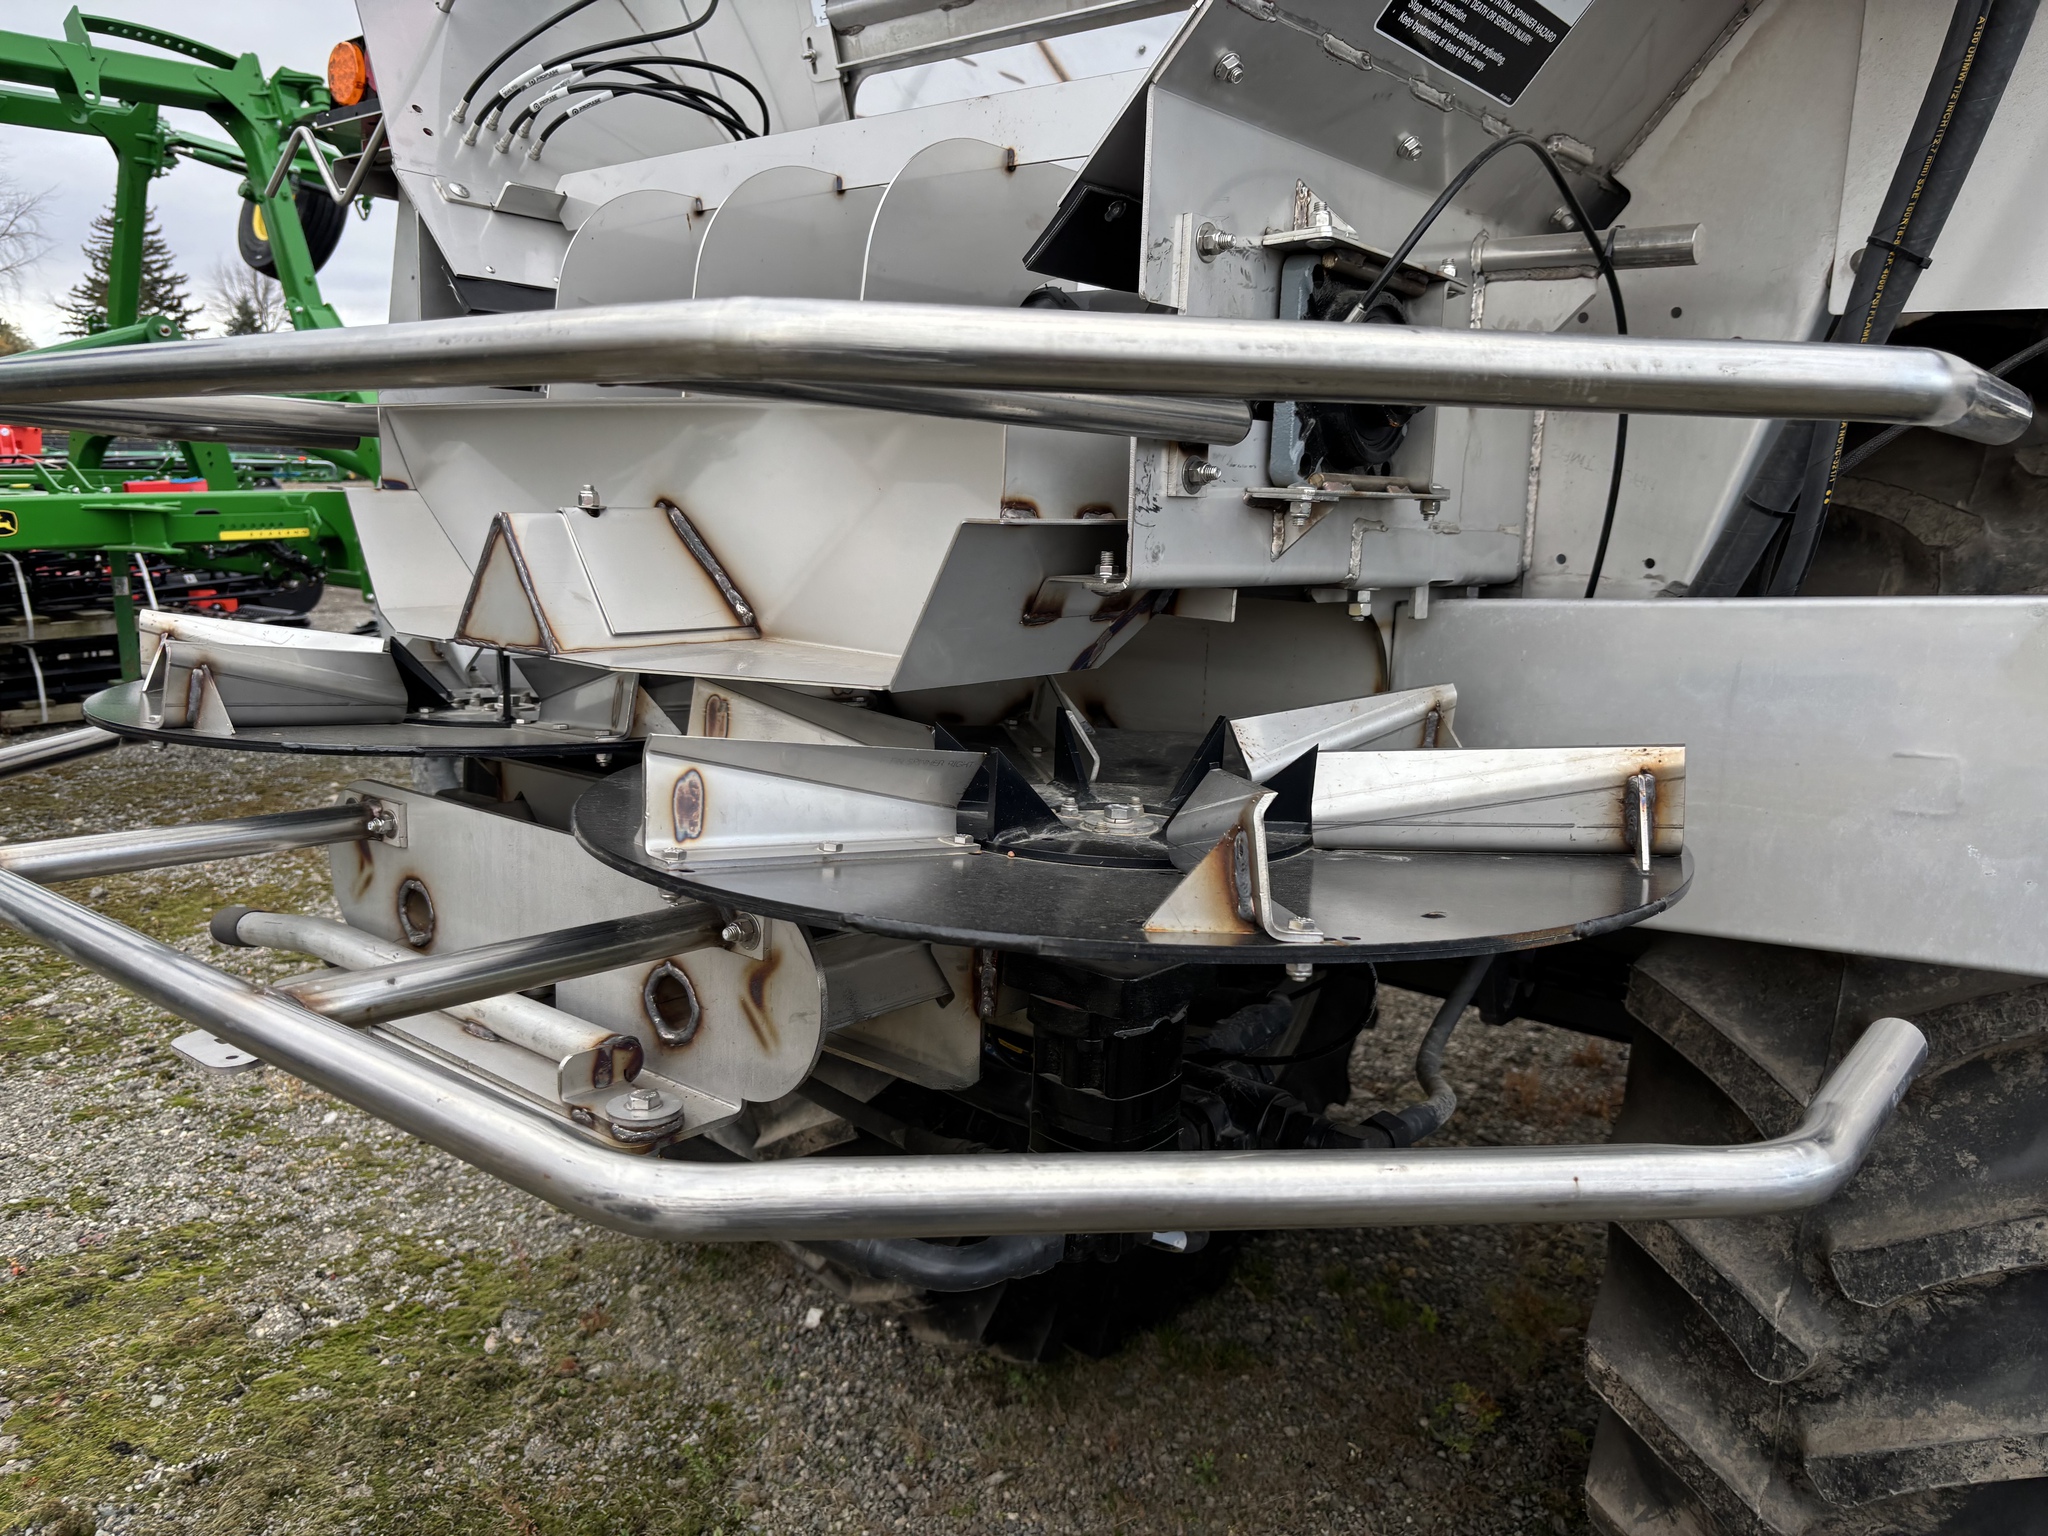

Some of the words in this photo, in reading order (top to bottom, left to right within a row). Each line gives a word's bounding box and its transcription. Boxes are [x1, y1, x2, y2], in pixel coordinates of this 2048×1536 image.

[1438, 1, 1468, 23] protection.
[1472, 0, 1491, 17] DEATH
[1486, 9, 1497, 22] OR
[1493, 14, 1517, 35] SERIOUS
[1489, 0, 1516, 15] TATING
[1512, 7, 1538, 31] SPINNER
[1533, 23, 1557, 43] HAZARD
[1397, 10, 1414, 29] Keep
[1412, 19, 1441, 44] bystanders
[1438, 38, 1447, 48] at
[1443, 40, 1459, 55] least
[1456, 47, 1466, 59] 60
[1462, 51, 1476, 64] feet
[1471, 57, 1486, 73] away.
[1408, 0, 1423, 14] Stop
[1420, 7, 1443, 26] machine
[1441, 18, 1459, 36] before
[1456, 30, 1480, 51] servicing
[1477, 43, 1486, 52] or
[1482, 46, 1506, 67] adjusting.
[1971, 16, 1986, 43] A150
[1958, 46, 1975, 81] UHMW
[1950, 84, 1962, 99] 1/2
[1940, 101, 1956, 127] INCH
[1911, 178, 1925, 198] SAE
[1877, 268, 1889, 290] 4000
[1871, 292, 1882, 308] PSI
[1861, 310, 1876, 343] FLAME
[906, 757, 945, 767] SPINNER
[947, 760, 975, 769] RIGHT
